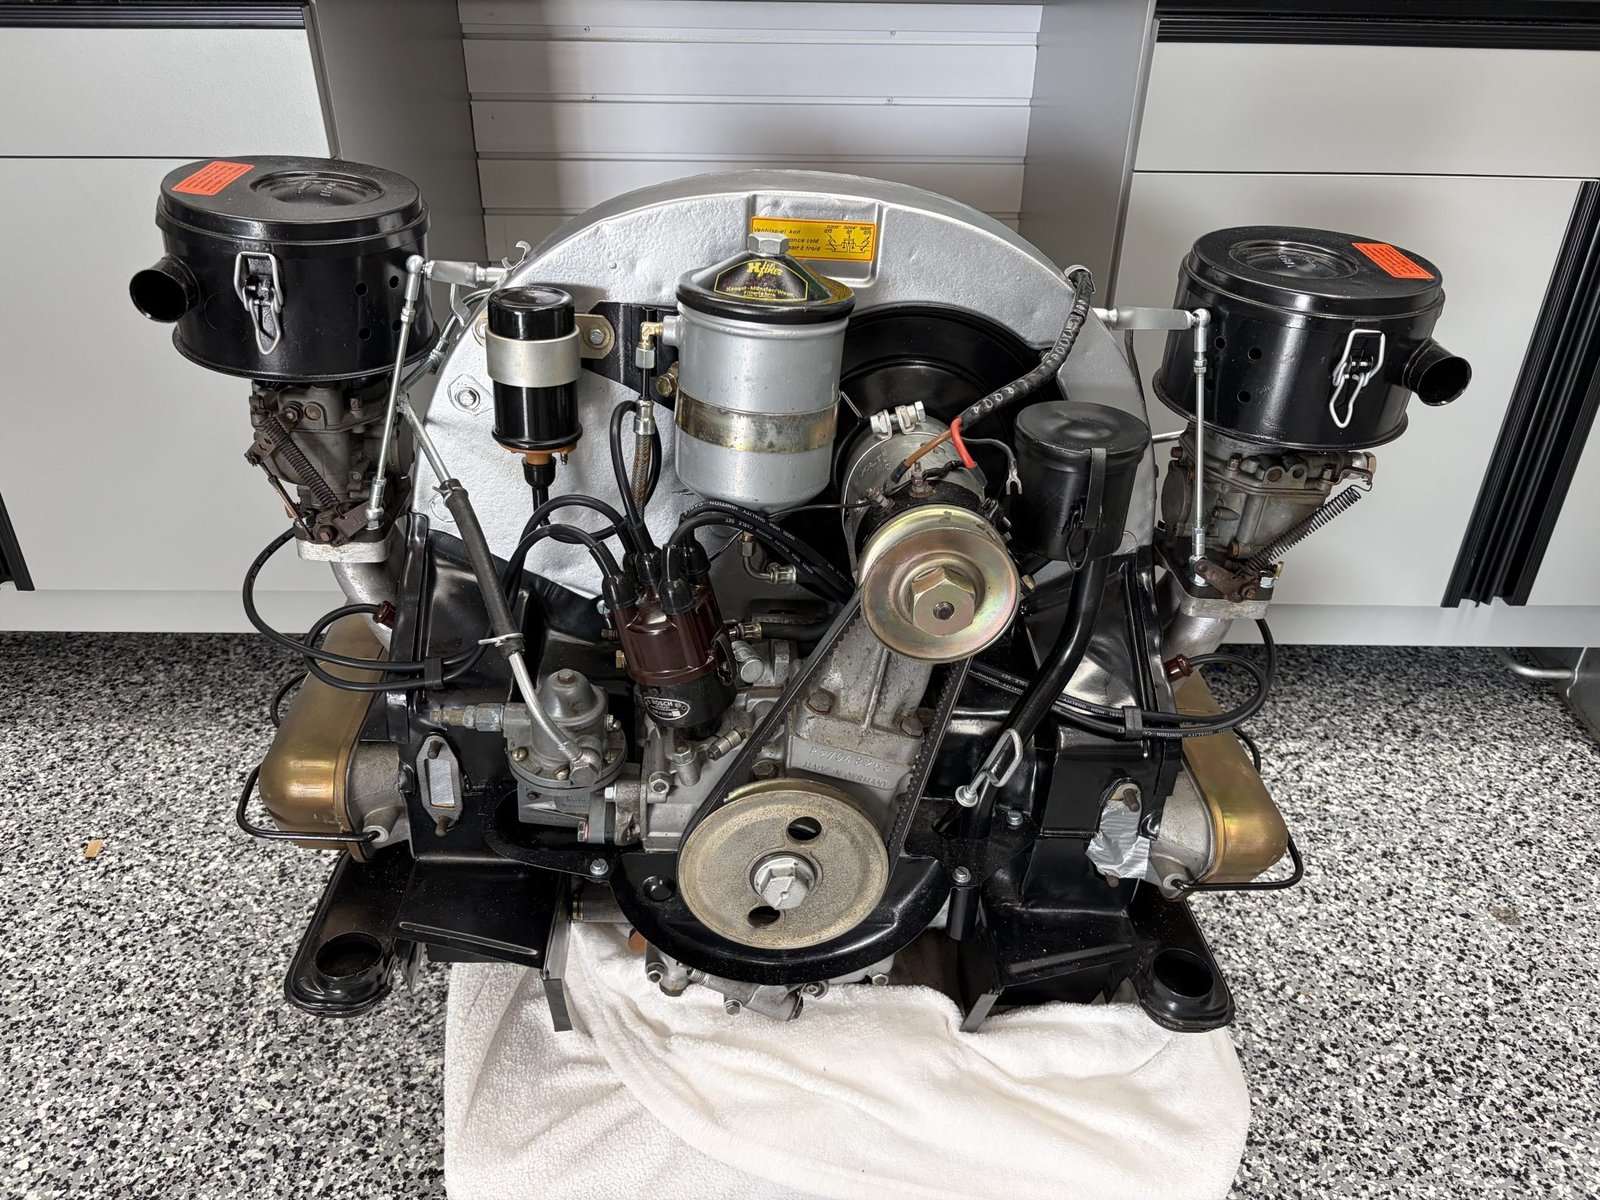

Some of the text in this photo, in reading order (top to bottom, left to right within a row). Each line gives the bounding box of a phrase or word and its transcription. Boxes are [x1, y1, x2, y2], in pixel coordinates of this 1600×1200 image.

[709, 500, 739, 511] IGNITION
[725, 517, 736, 525] SET
[742, 509, 767, 524] QUALITY
[1062, 697, 1087, 710] QUALITY
